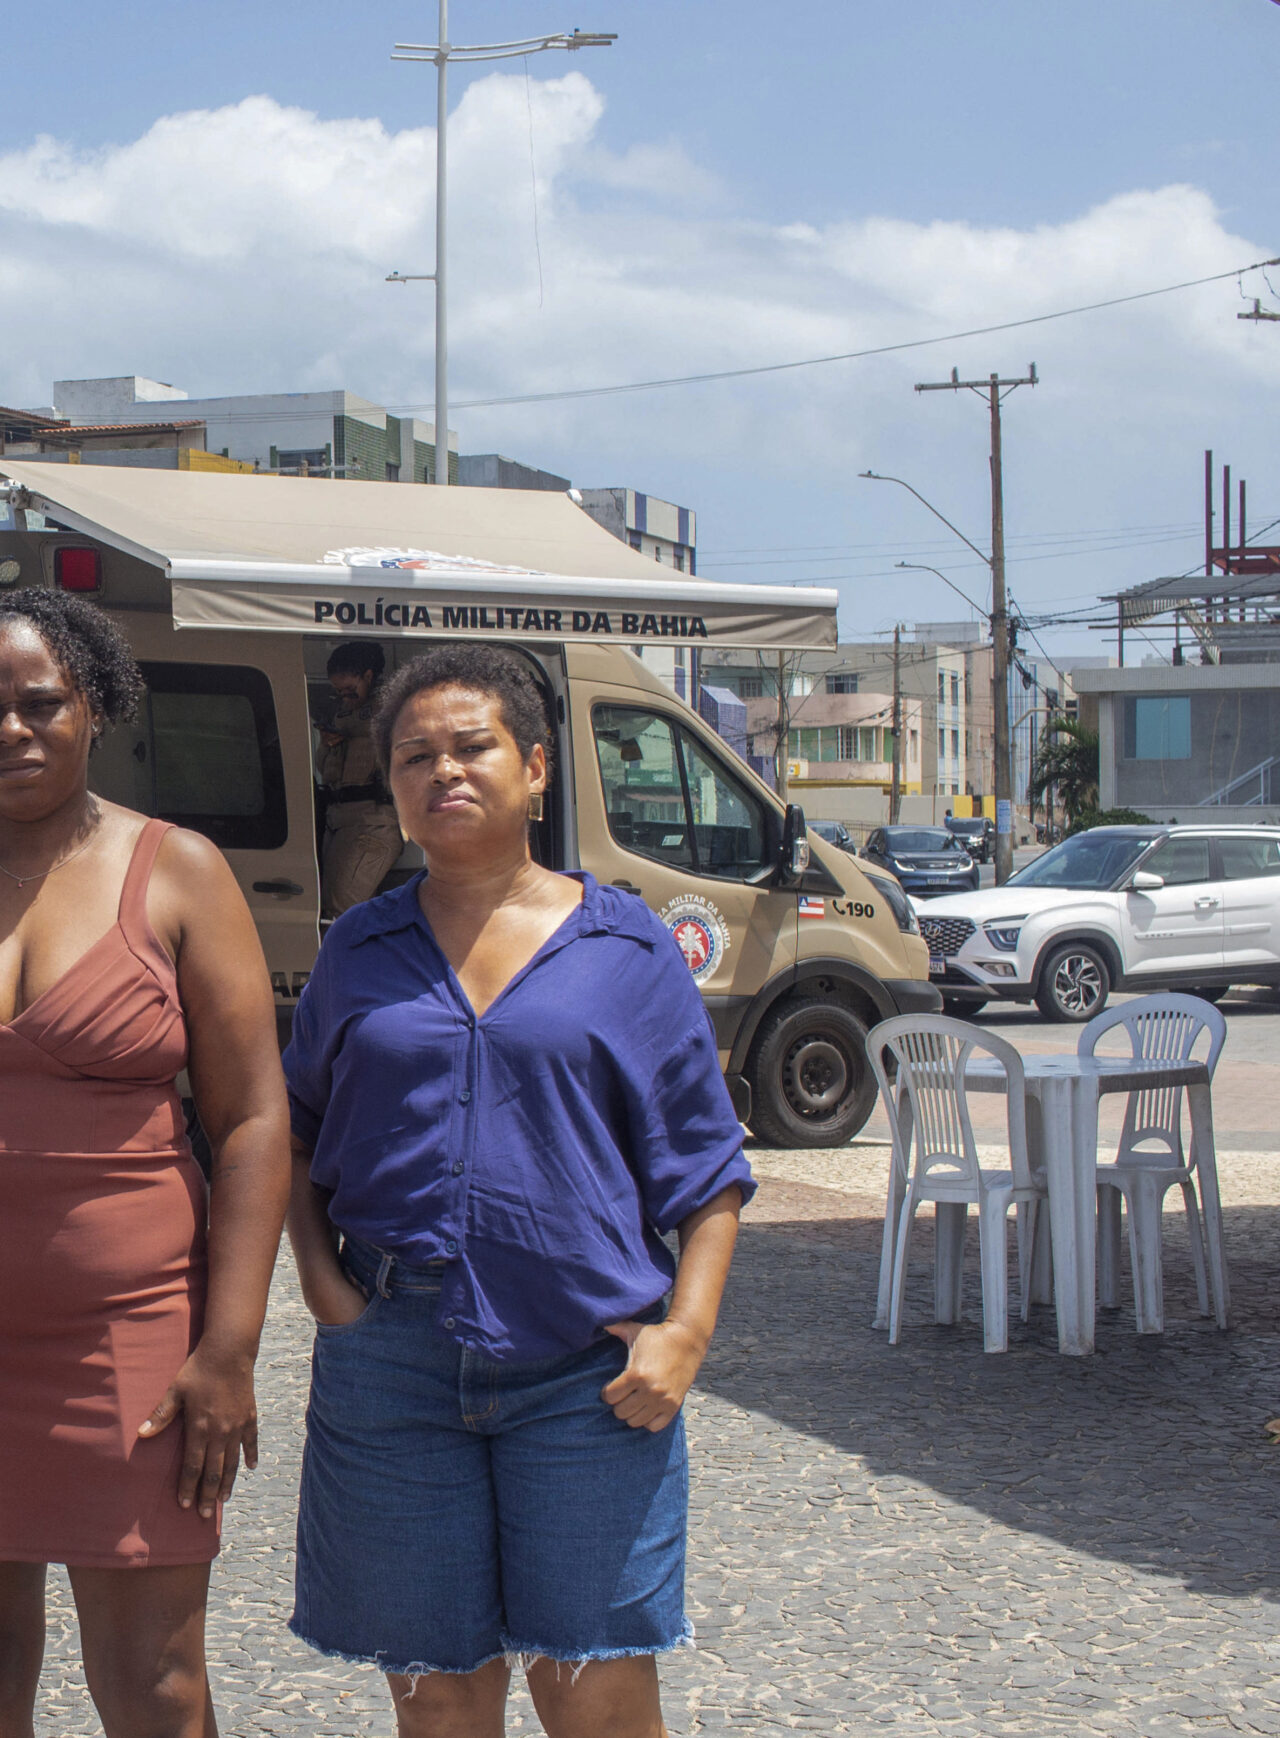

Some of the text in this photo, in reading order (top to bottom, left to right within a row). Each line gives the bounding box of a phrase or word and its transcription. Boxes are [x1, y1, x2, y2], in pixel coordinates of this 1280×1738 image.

[314, 597, 708, 638] POLÍCIA MILITAR DA BAHIA
[668, 893, 731, 949] MILITAR DA BAHIA
[845, 902, 875, 918] 190
